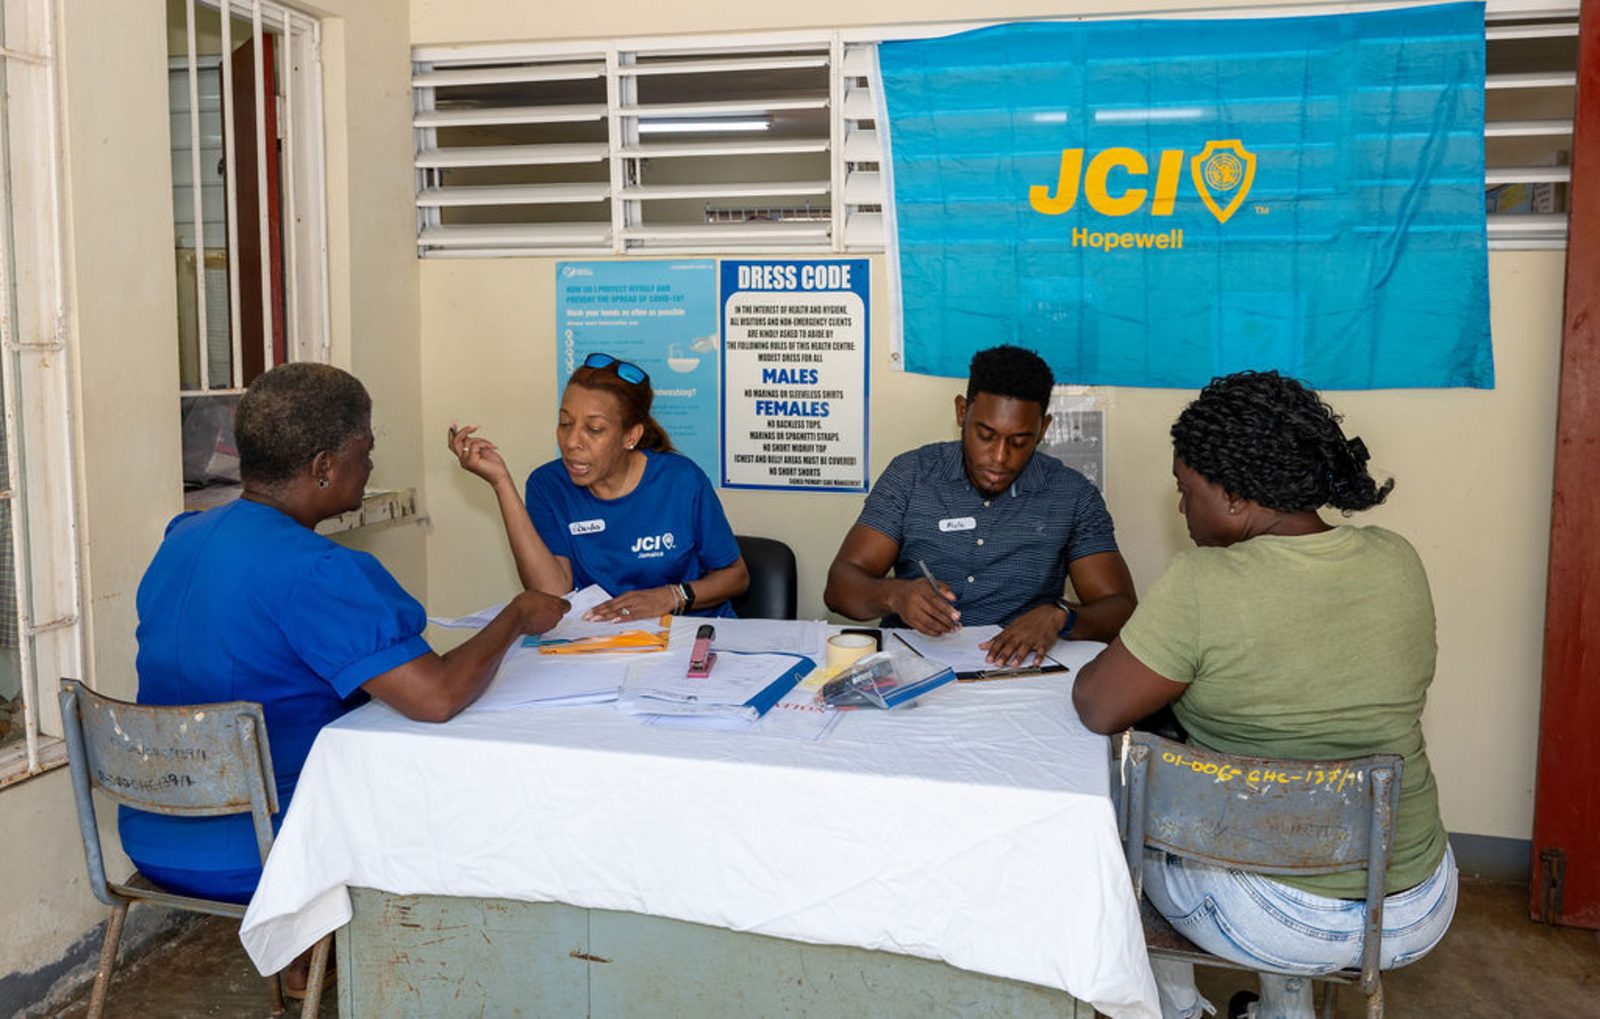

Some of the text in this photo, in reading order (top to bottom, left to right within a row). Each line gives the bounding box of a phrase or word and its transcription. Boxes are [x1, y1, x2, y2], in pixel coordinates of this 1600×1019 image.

[1029, 147, 1184, 216] JCI
[1071, 227, 1183, 252] Hopewell
[738, 265, 852, 289] DRESS CODE
[753, 305, 779, 314] INTEREST
[780, 305, 787, 314] OF
[788, 305, 808, 314] HEALTH
[810, 305, 821, 314] AND
[740, 317, 766, 327] VISITORS
[767, 317, 778, 327] AND
[828, 317, 852, 327] CLIENTS
[748, 330, 833, 338] ARE KINDLY ASKED TO ABIDE BY
[737, 342, 769, 350] FOLLOWING
[770, 342, 787, 350] RULES
[789, 342, 795, 350] OF
[797, 342, 809, 350] THIS
[811, 342, 831, 350] HEALTH
[758, 353, 781, 362] MODEST
[782, 353, 800, 362] DRESS
[802, 353, 812, 362] FOR
[762, 368, 818, 385] MALES
[744, 389, 752, 398] NO
[780, 390, 788, 398] OR
[789, 390, 821, 398] SLEEVELESS
[756, 400, 829, 417] FEMALES
[767, 420, 775, 429] NO
[776, 420, 805, 429] BACKLESS
[777, 432, 784, 440] OR
[785, 432, 816, 440] SPAGHETTI
[763, 443, 827, 453] NO SHORT MIDRIFF TOP
[756, 455, 766, 463] AND
[768, 455, 783, 464] BELLY
[784, 455, 802, 464] AREAS
[803, 456, 819, 464] MUST
[820, 456, 827, 464] BE
[769, 467, 821, 476] NO SHORT SHORTS
[631, 536, 661, 552] JCI
